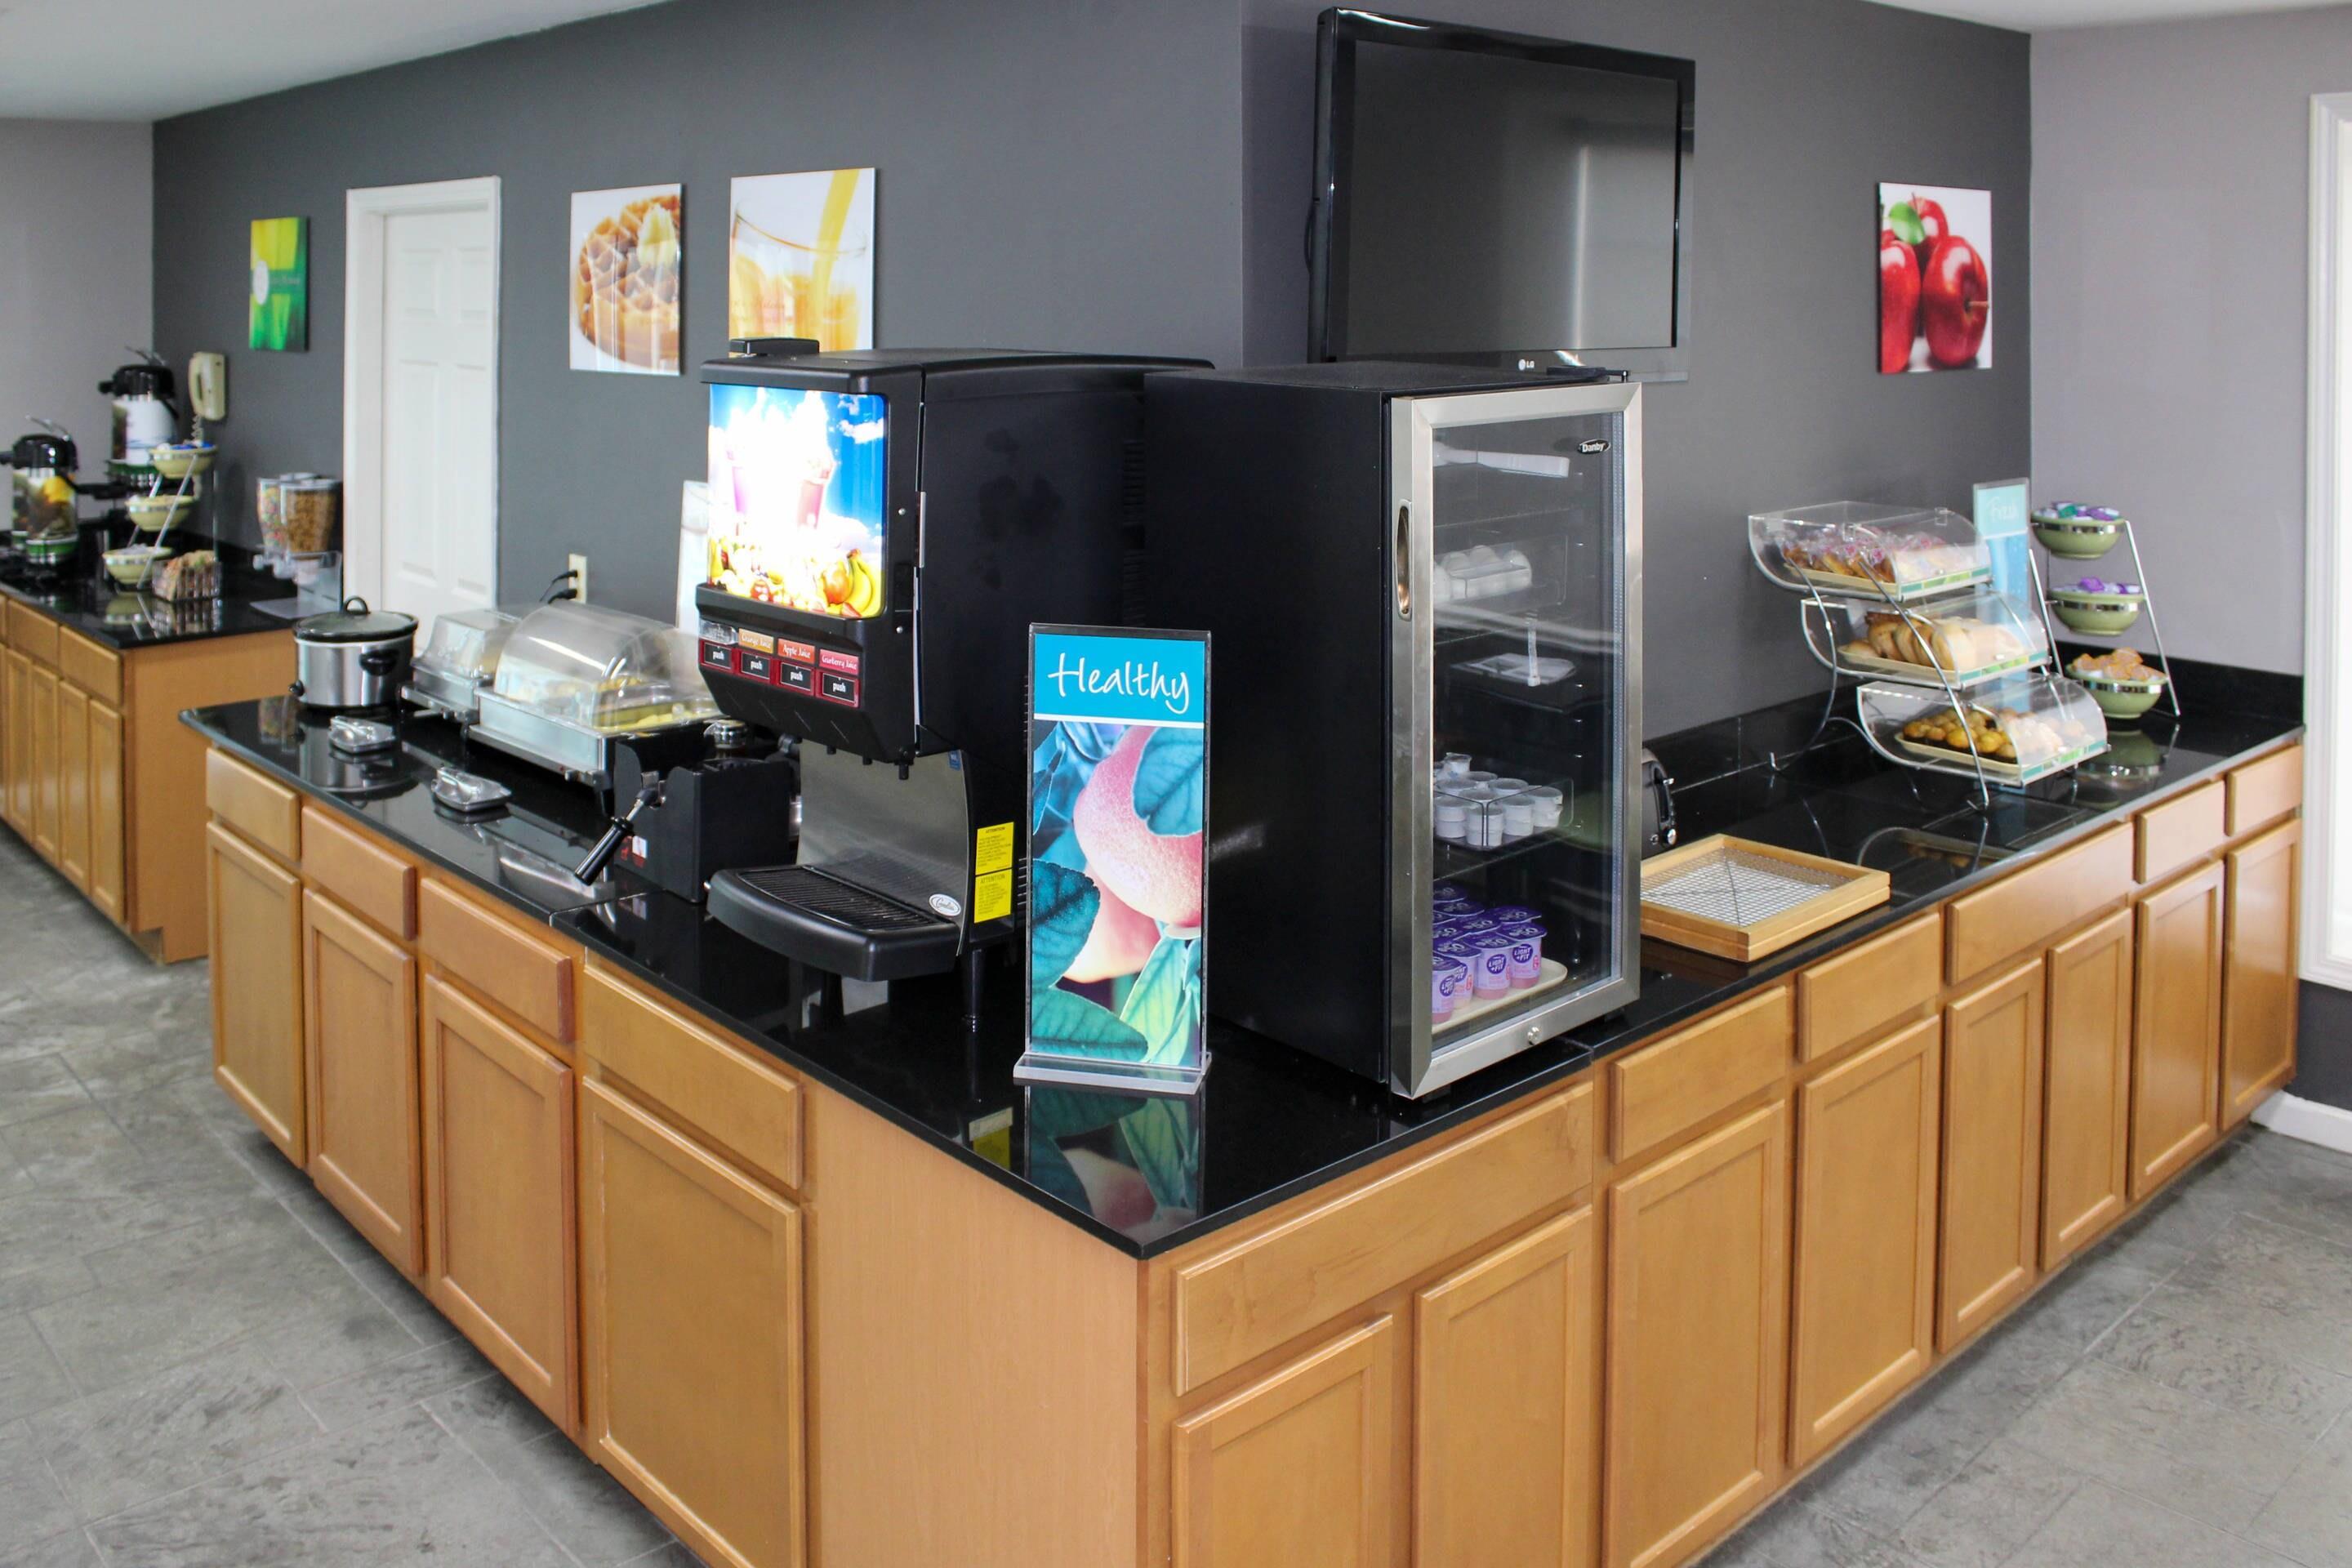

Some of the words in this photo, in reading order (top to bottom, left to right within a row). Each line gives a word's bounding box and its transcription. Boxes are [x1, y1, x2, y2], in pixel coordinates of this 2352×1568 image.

[1582, 442, 1605, 452] Danby
[712, 651, 725, 661] push
[782, 644, 798, 657] Apple
[798, 646, 811, 659] Juice
[750, 660, 763, 670] push
[822, 654, 845, 669] Cranberry
[845, 660, 858, 670] Juice
[790, 670, 804, 681] push
[832, 682, 846, 693] push
[1047, 652, 1190, 715] Healthy
[981, 874, 1006, 884] ATTENTION
[1513, 947, 1532, 956] LIGHT
[1488, 956, 1505, 968] LIGHT
